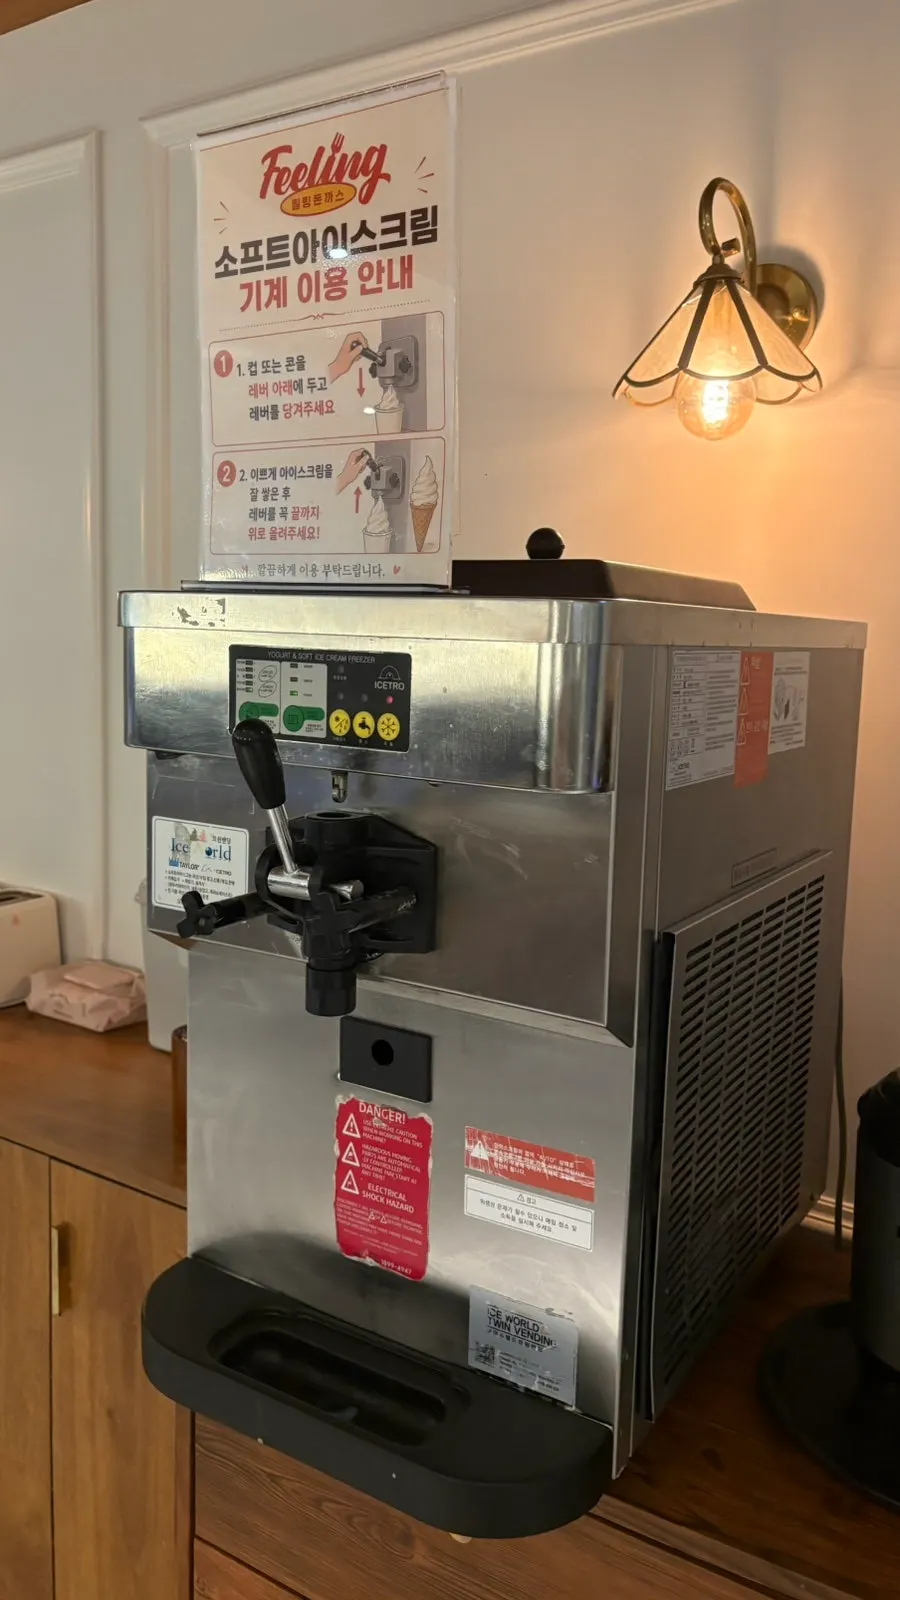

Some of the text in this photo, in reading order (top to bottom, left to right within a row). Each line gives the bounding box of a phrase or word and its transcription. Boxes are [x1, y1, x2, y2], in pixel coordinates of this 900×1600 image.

[259, 133, 391, 205] Feeling
[214, 204, 439, 280] 소프트아이스크림
[239, 254, 414, 313] 기계 이용 안내
[236, 354, 306, 377] 1. 컵 또는 콘을
[248, 376, 328, 399] 레버 아래에 두고
[249, 399, 336, 421] 레버를 당겨주세요
[239, 463, 334, 482] 2. 이쁘게 아이스크림을
[249, 485, 291, 502] 잘 쌓은 후
[248, 505, 320, 522] 레버를 꼭 끝까지
[248, 525, 321, 542] 위로 올려주세요!
[257, 562, 386, 580] 깔끔하게 이용 부탁드립니다.
[267, 650, 376, 665] YOGURT & SOFT ICE CREAM FREEZER
[374, 681, 406, 692] ICETRO
[171, 837, 190, 854] Ice
[179, 861, 200, 871] TAYLOR
[359, 1101, 406, 1126] DANGER!
[362, 1189, 415, 1214] SHOCK HAZARD
[367, 1182, 407, 1202] ELECTRICAL
[487, 1307, 540, 1333] ICE WORLD
[487, 1317, 511, 1333] TWIN
